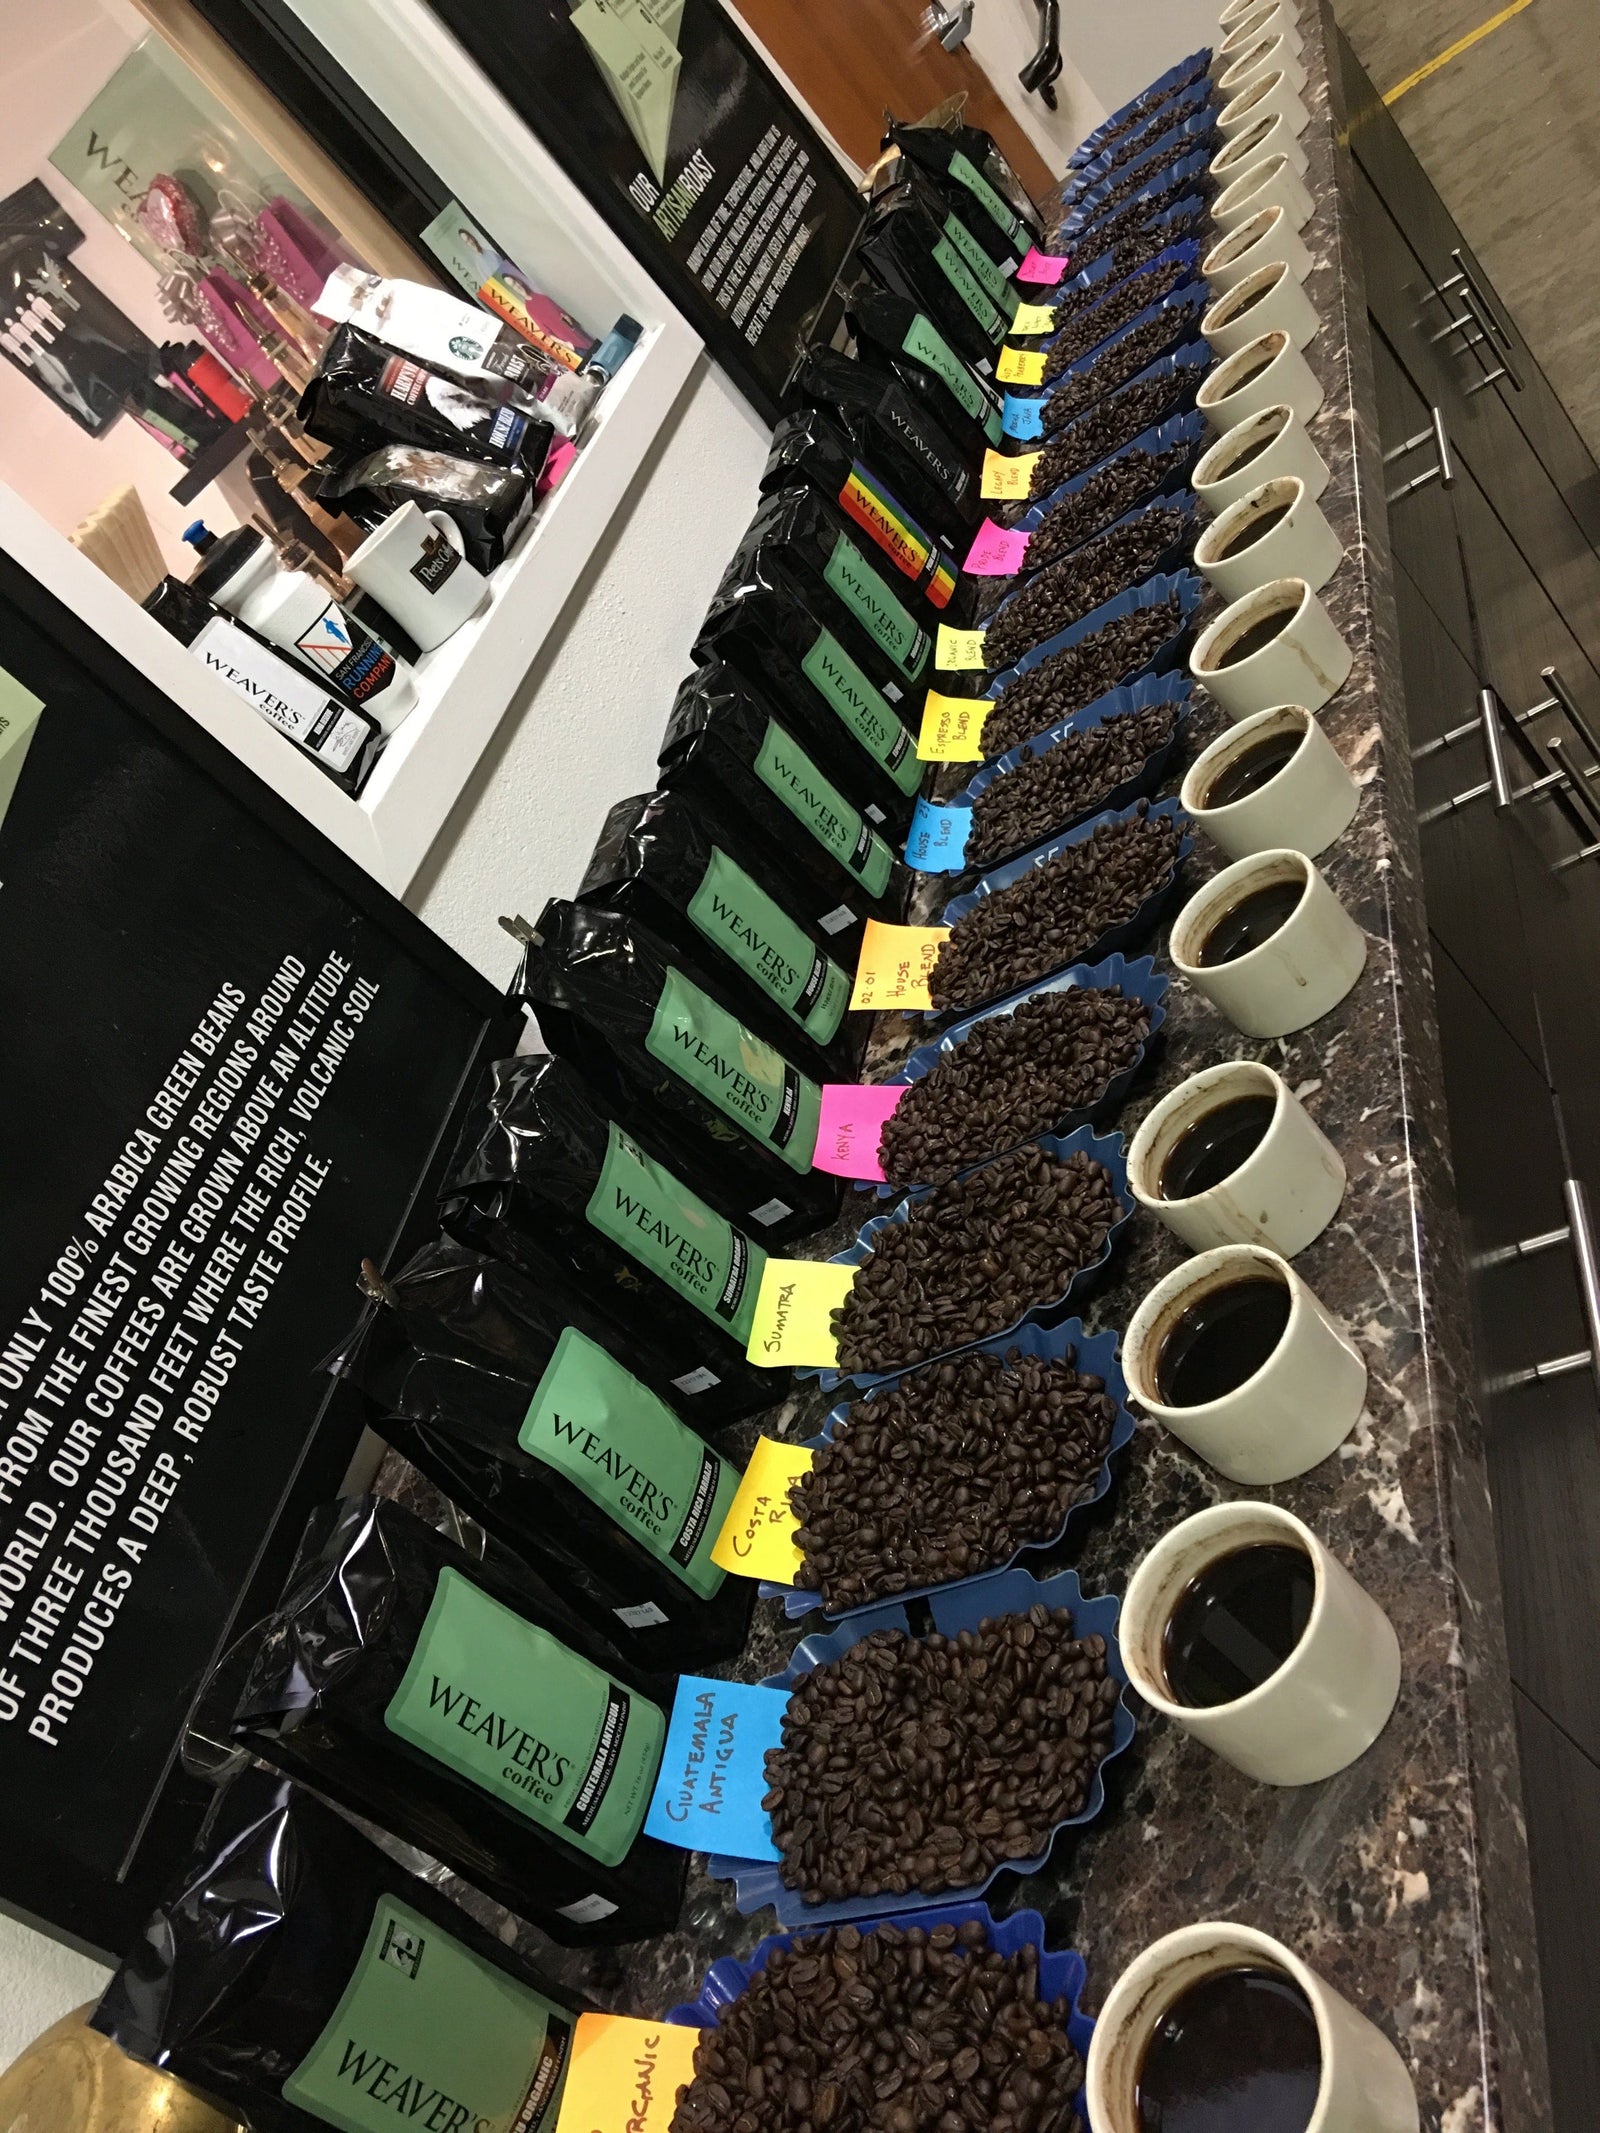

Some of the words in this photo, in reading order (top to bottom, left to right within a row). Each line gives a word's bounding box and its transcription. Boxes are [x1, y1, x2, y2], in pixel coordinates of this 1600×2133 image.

[764, 166, 778, 182] OF
[768, 152, 786, 174] EACH
[796, 149, 810, 168] AND
[629, 172, 660, 213] OUR
[710, 216, 723, 233] OF
[748, 151, 763, 171] AND
[769, 123, 782, 138] IS
[748, 175, 773, 209] POTENTIAL
[805, 174, 817, 188] TO
[741, 200, 756, 219] THE
[756, 199, 781, 232] BETWEEN
[788, 182, 814, 217] COMPANIES
[726, 211, 751, 245] UNLOCKS
[774, 226, 787, 243] BY
[779, 211, 797, 235] LARGE
[715, 236, 736, 264] ROAST
[738, 224, 768, 265] DIFFERENCE
[766, 235, 784, 258] USED
[784, 240, 803, 266] EVERY
[700, 268, 718, 292] HOW
[708, 255, 725, 277] OUR
[725, 268, 742, 288] THE
[731, 256, 749, 277] KEY
[747, 250, 776, 292] MACHINERY
[770, 258, 795, 293] PROCESS
[714, 288, 733, 310] THIS
[721, 280, 736, 296] IS
[761, 284, 781, 310] SAME
[729, 285, 759, 328] AUTOMATED
[755, 301, 771, 321] THE
[743, 314, 765, 346] REPEAT
[891, 410, 950, 480] WEAVER'S
[1007, 467, 1020, 486] BLEND
[856, 489, 918, 563] WEAVER'S
[994, 540, 1010, 562] BLEND
[841, 566, 904, 646] WEAVER'S
[205, 651, 303, 725] WEAVER'S
[335, 663, 352, 681] SAN
[821, 655, 887, 742] WEAVER'S
[258, 703, 295, 731] coffee
[854, 716, 880, 748] coffee
[930, 711, 951, 755] ESPRESSO
[952, 711, 970, 742] BLEND
[774, 755, 849, 842] WEAVER'S
[814, 817, 843, 850] coffee
[917, 831, 930, 861] HOUSE
[934, 818, 953, 848] BLEND
[712, 894, 798, 986] WEAVER'S
[756, 962, 787, 995] coffee
[886, 961, 910, 999] HOUSE
[910, 943, 936, 990] BLEND
[673, 1024, 771, 1113] WEAVER'S
[725, 1091, 762, 1124] coffee
[831, 1123, 855, 1160] KENYA
[0, 1306, 53, 1390] ONLY
[40, 1235, 99, 1308] 100%
[84, 1128, 162, 1238] ARABICA
[146, 1049, 206, 1130] GREEN
[190, 981, 246, 1057] BEANS
[34, 1346, 87, 1407] THE
[68, 1250, 138, 1352] FINEST
[123, 1136, 205, 1256] GROWING
[188, 1039, 258, 1141] REGIONS
[245, 954, 306, 1046] AROUND
[48, 1418, 103, 1487] OUR
[85, 1296, 166, 1418] COFFEES
[150, 1239, 196, 1300] ARE
[179, 1147, 245, 1244] GROWN
[229, 1074, 284, 1155] ABOVE
[269, 1042, 301, 1083] AN
[287, 949, 351, 1051] ALTITUDE
[614, 1186, 717, 1283] WEAVER'S
[670, 1260, 708, 1295] coffee
[723, 1266, 740, 1304] SUMATRA
[8, 1555, 85, 1665] THREE
[63, 1393, 164, 1554] THOUSAND
[148, 1321, 199, 1394] FEET
[182, 1230, 248, 1325] WHERE
[229, 1182, 272, 1233] THE
[255, 1126, 307, 1188] RICH,
[288, 1019, 355, 1122] VOLCANIC
[342, 976, 380, 1024] SOIL
[763, 1283, 797, 1353] SUMATRA
[28, 1563, 133, 1747] PRODUCES
[116, 1536, 148, 1565] A
[172, 1327, 243, 1444] ROBUST
[226, 1249, 283, 1329] TASTE
[266, 1153, 333, 1254] PROFILE.
[553, 1412, 674, 1521] WEAVER'S
[619, 1495, 662, 1536] coffee
[679, 1516, 697, 1548] COSTA
[691, 1492, 705, 1517] RICA
[698, 1460, 714, 1495] TARRAZU
[769, 1475, 802, 1524] RIA
[733, 1495, 772, 1558] COSTA
[428, 1674, 571, 1788] WEAVER'S
[576, 1746, 610, 1813] GUATEMALA
[601, 1701, 620, 1749] ANTIGUA
[608, 1748, 618, 1767] SILKY
[665, 1691, 716, 1823] GUATEMALA
[698, 1713, 739, 1815] ANTIGUA
[502, 1764, 554, 1806] coffee
[521, 2055, 553, 2122] ORGANIC
[625, 2034, 661, 2133] RGANIC
